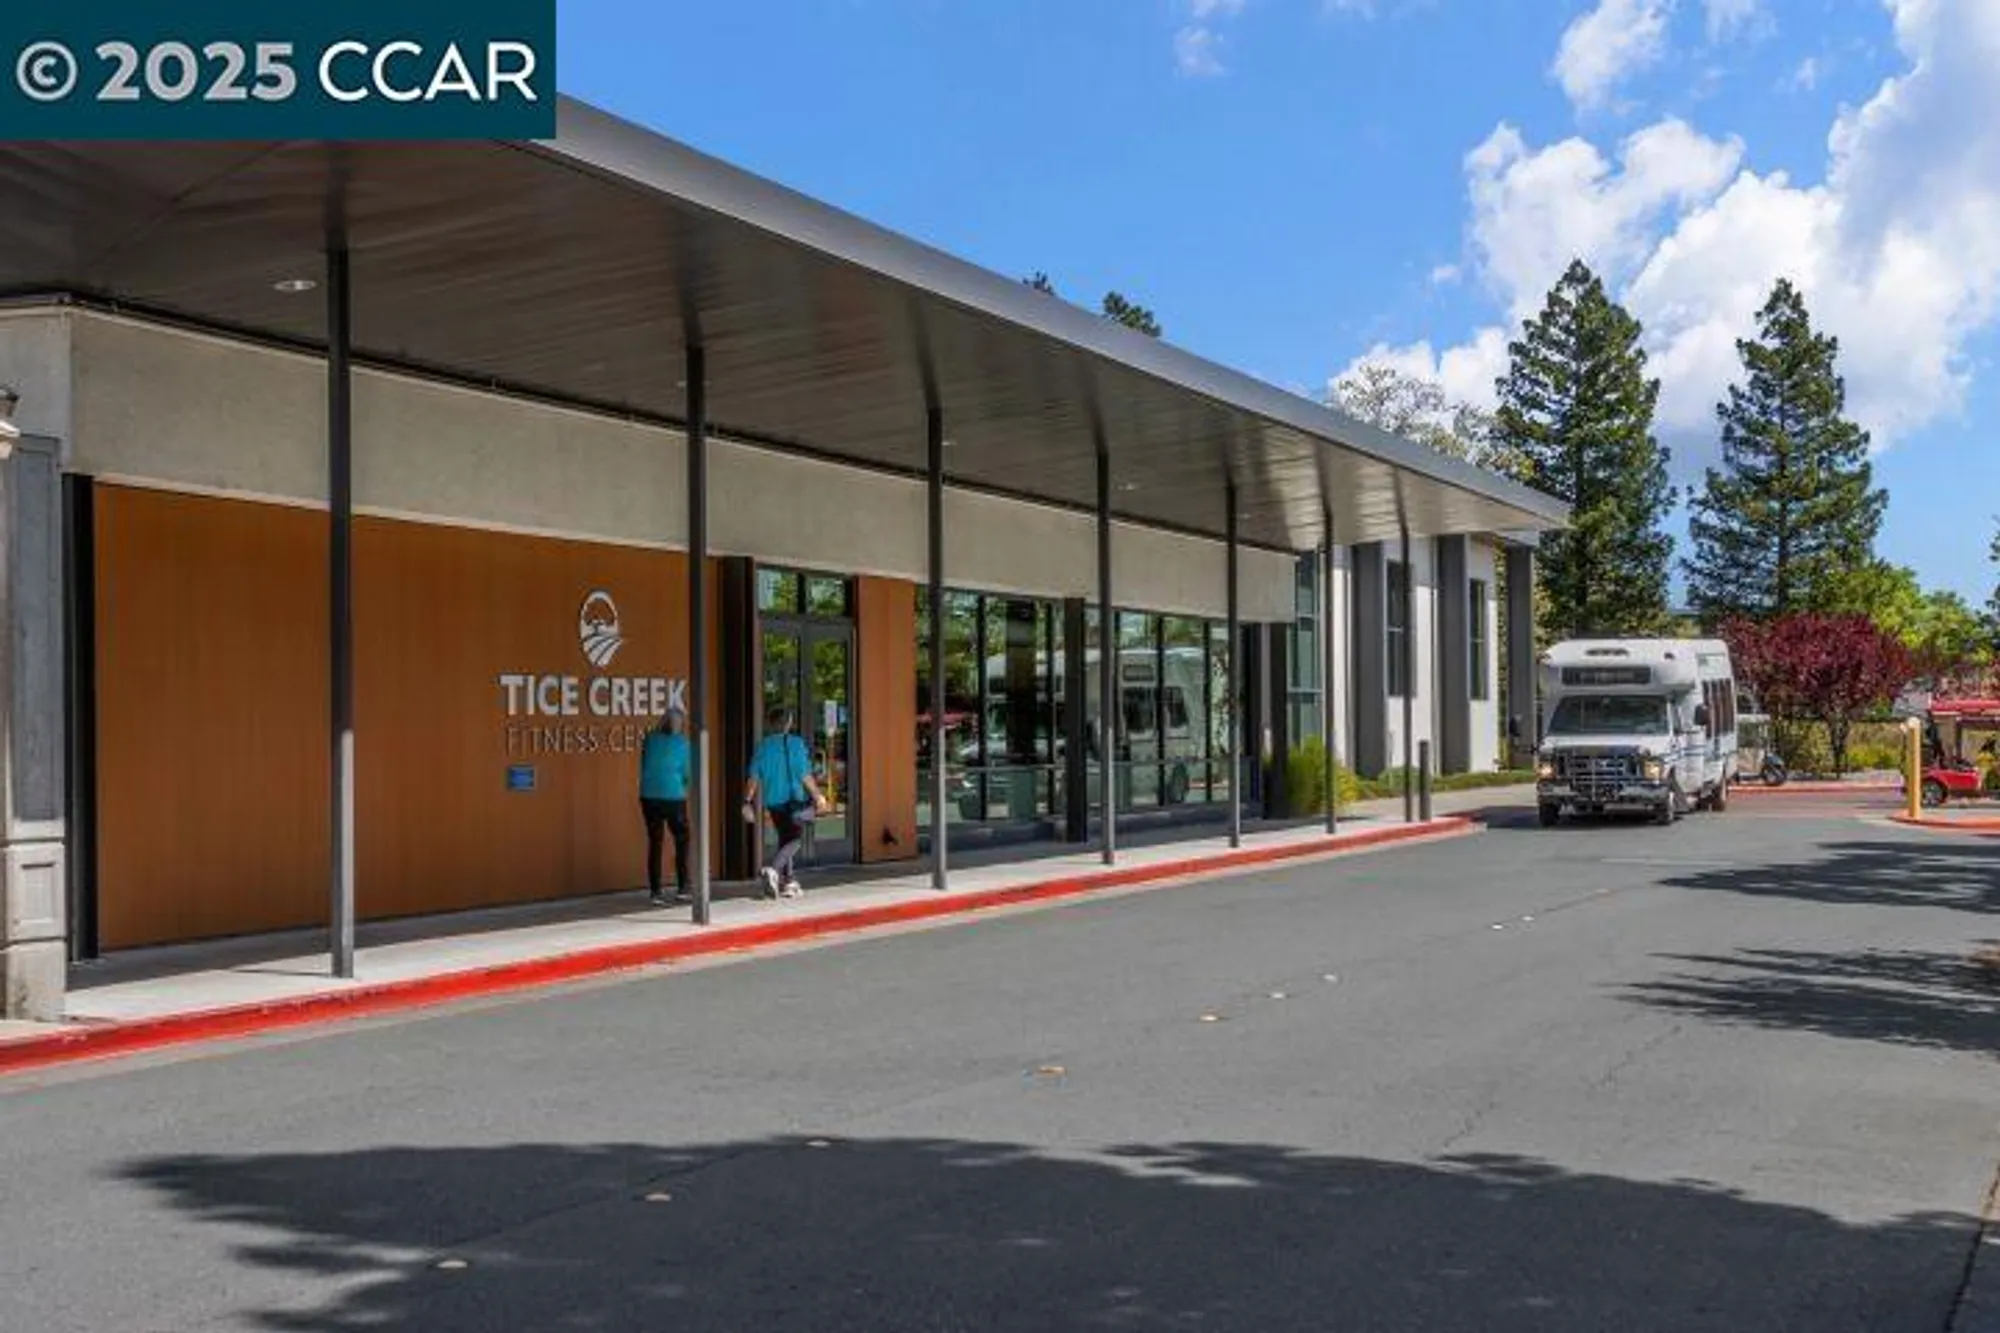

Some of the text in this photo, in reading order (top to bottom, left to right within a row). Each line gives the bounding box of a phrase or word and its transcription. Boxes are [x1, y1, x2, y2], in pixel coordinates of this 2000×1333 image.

[500, 674, 687, 716] TICE CREEK
[507, 725, 599, 753] FITNESS
